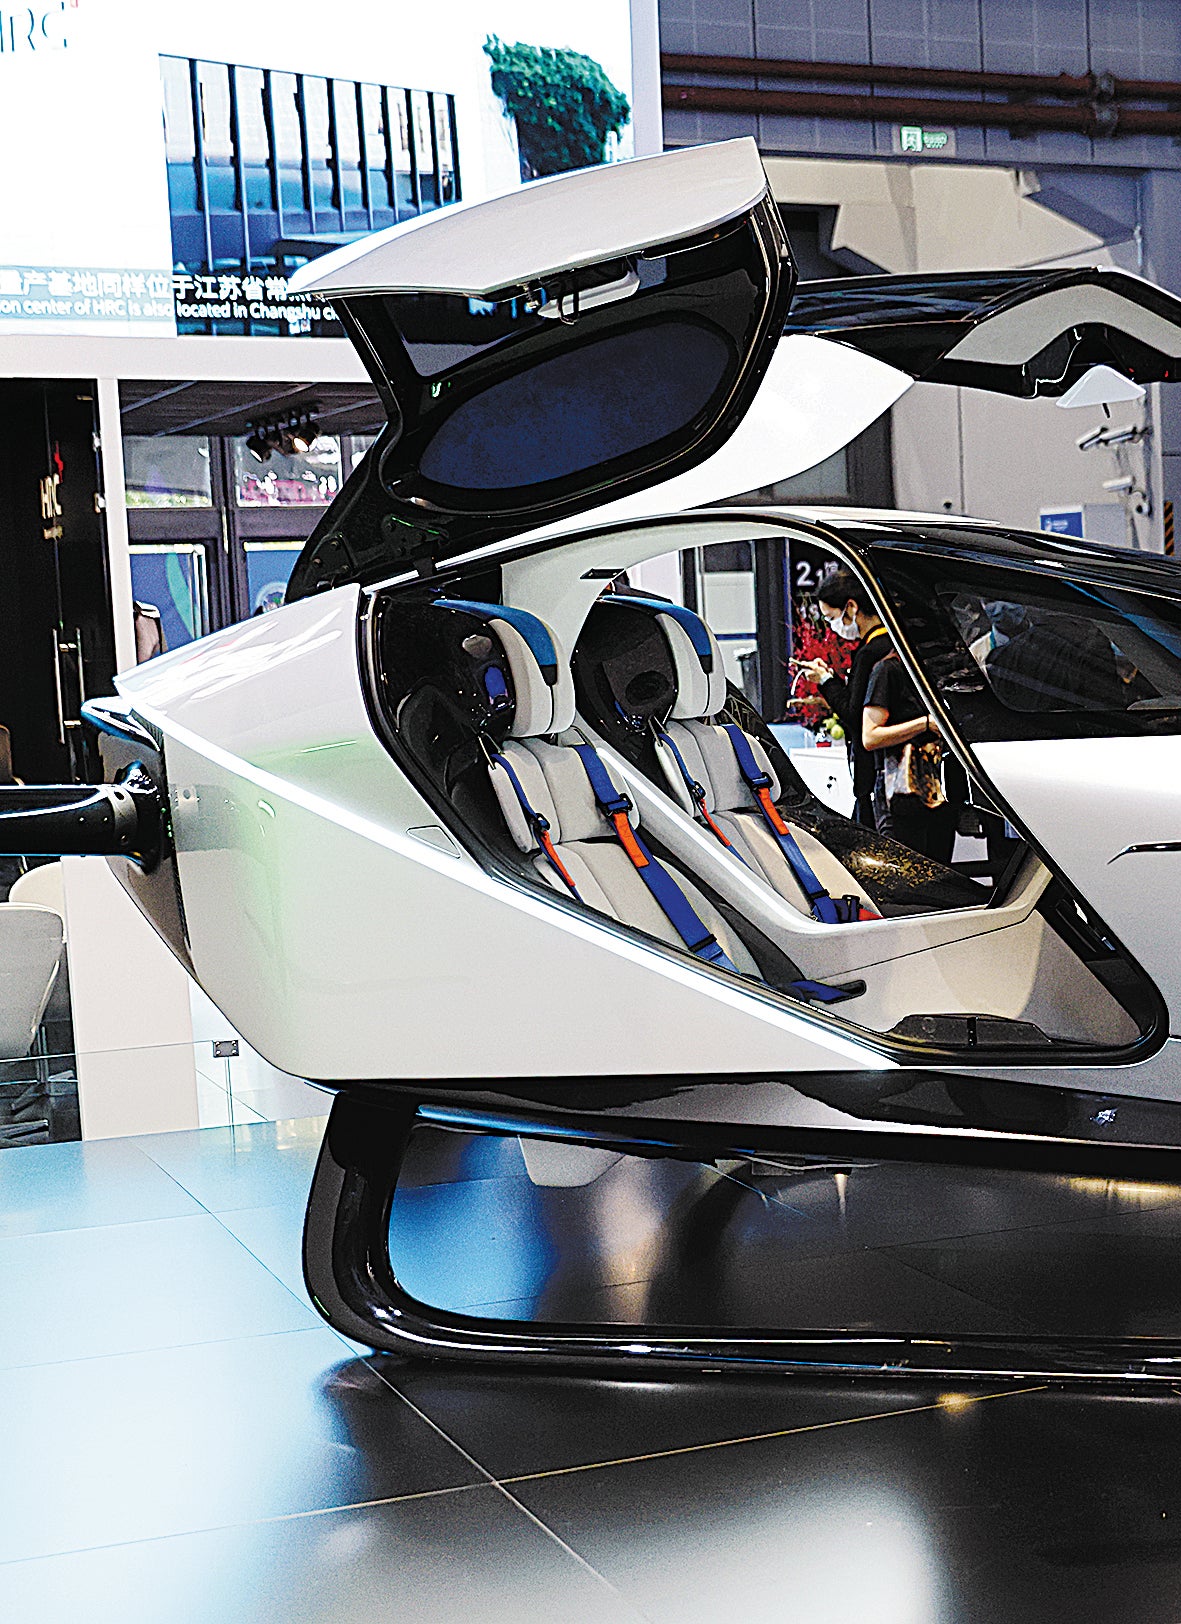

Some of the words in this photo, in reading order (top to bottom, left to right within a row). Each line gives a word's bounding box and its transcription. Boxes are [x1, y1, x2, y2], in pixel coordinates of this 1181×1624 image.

[23, 299, 73, 315] center
[74, 299, 91, 316] of
[93, 300, 127, 316] HRC
[129, 301, 141, 317] is
[176, 301, 231, 318] located
[233, 303, 248, 318] in
[250, 303, 321, 324] Changshu
